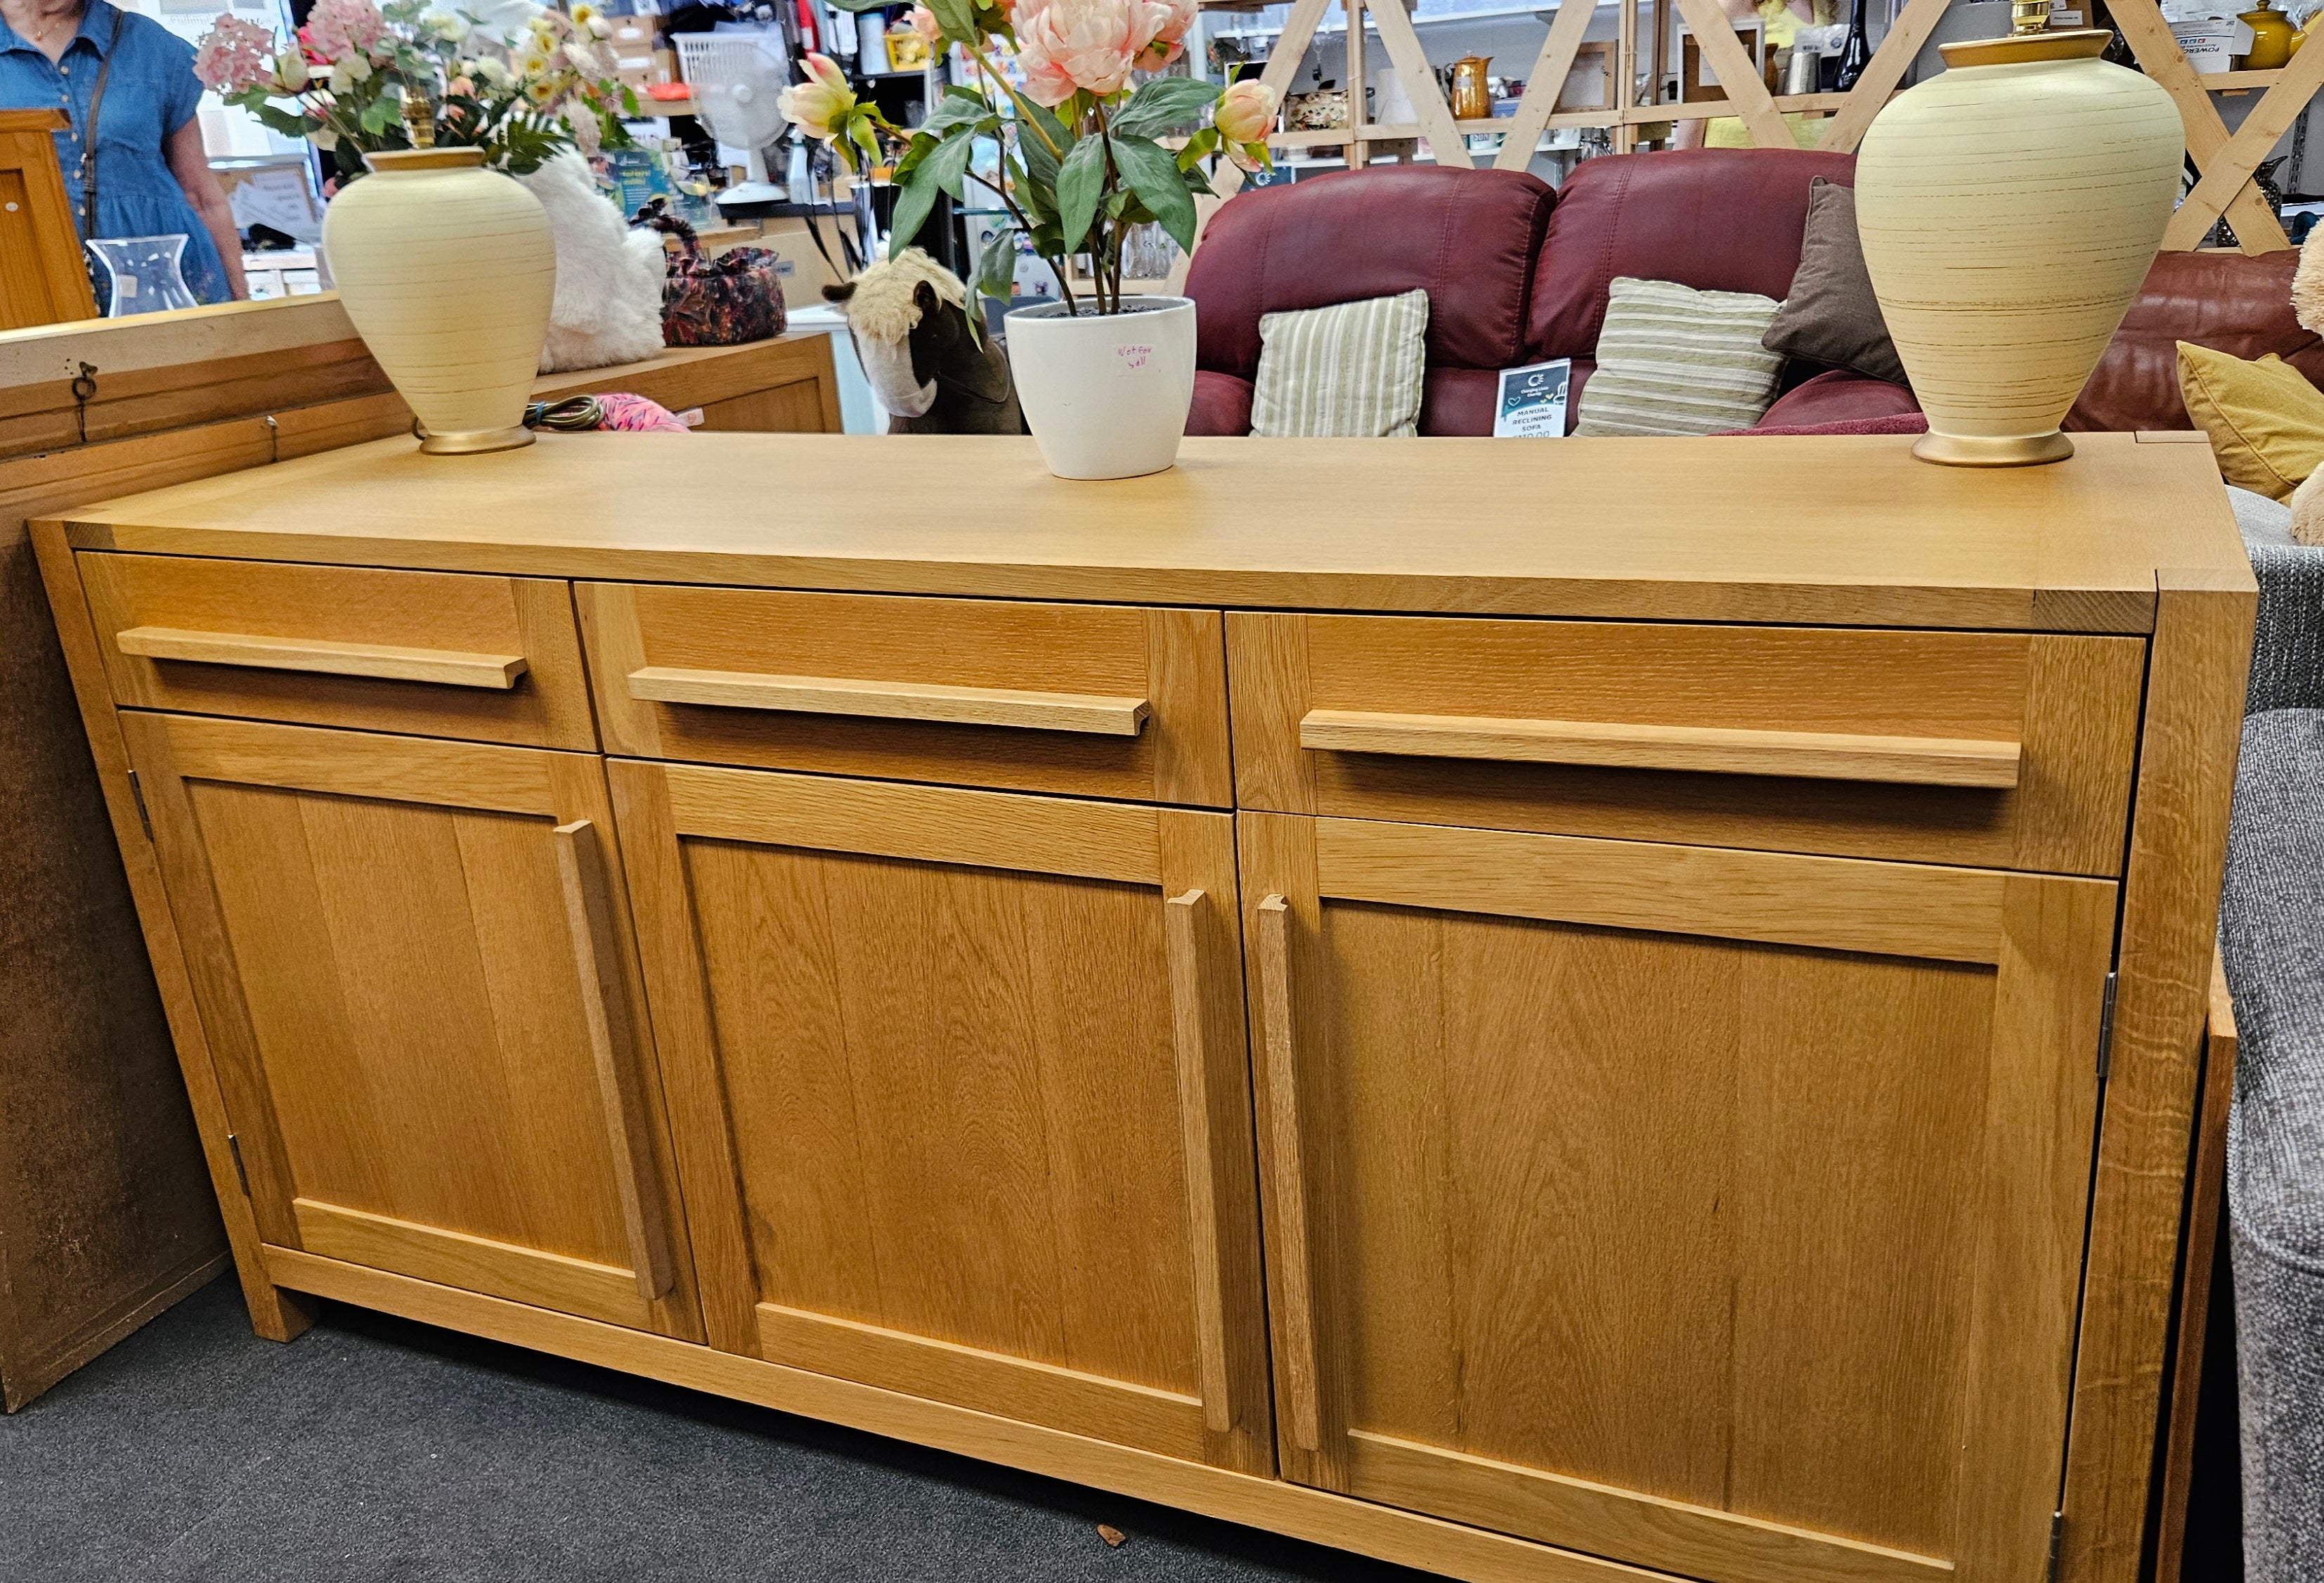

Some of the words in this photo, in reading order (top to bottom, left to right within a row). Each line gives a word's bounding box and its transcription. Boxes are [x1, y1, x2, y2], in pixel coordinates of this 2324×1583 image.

[1118, 345, 1136, 357] Not
[1517, 407, 1549, 417] MANUAL
[1512, 414, 1552, 425] RECLINING
[1521, 424, 1541, 432] SOFA
